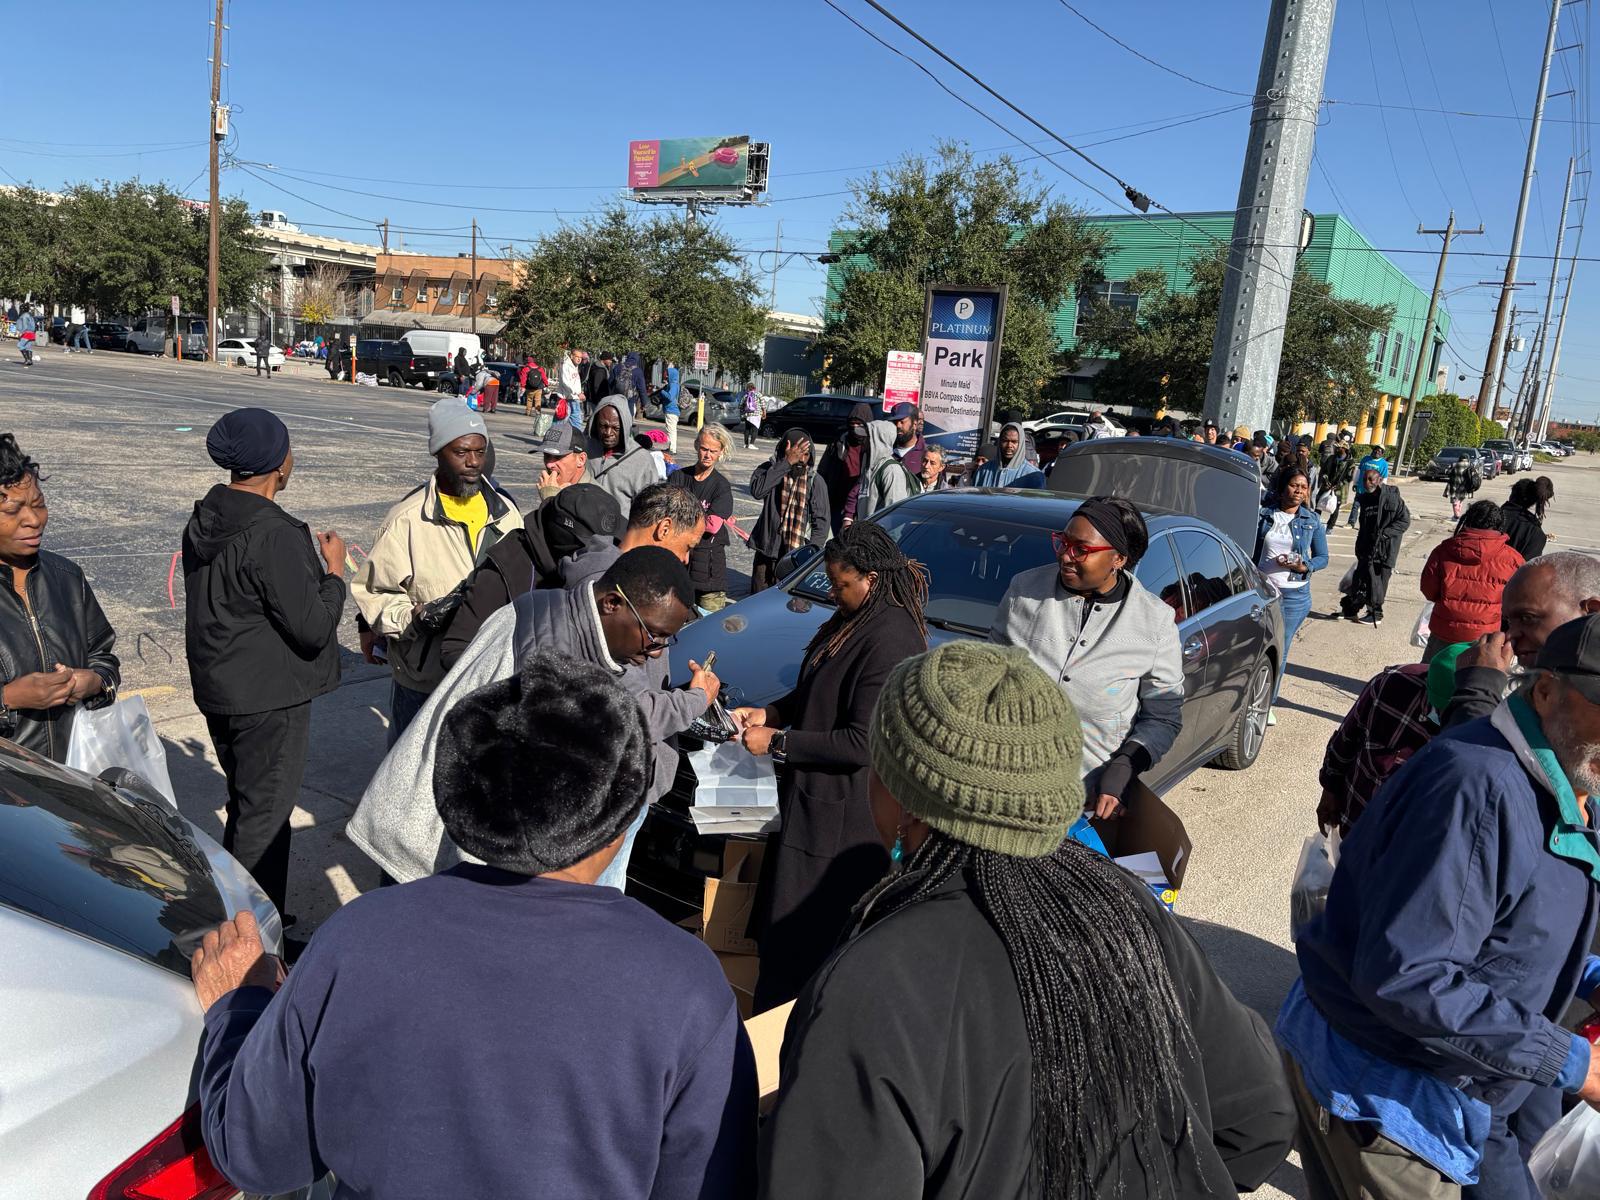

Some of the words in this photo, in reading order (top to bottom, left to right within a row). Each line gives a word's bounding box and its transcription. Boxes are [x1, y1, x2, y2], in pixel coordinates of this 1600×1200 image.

[959, 302, 969, 314] P
[932, 322, 992, 335] PLATINUM
[934, 346, 984, 369] Park
[941, 379, 957, 388] Minute
[958, 381, 971, 389] Maid
[925, 390, 939, 399] BBVA
[940, 392, 963, 402] Compass
[964, 394, 984, 404] Stadium
[925, 404, 950, 413] Downtown
[950, 406, 983, 416] Destinations
